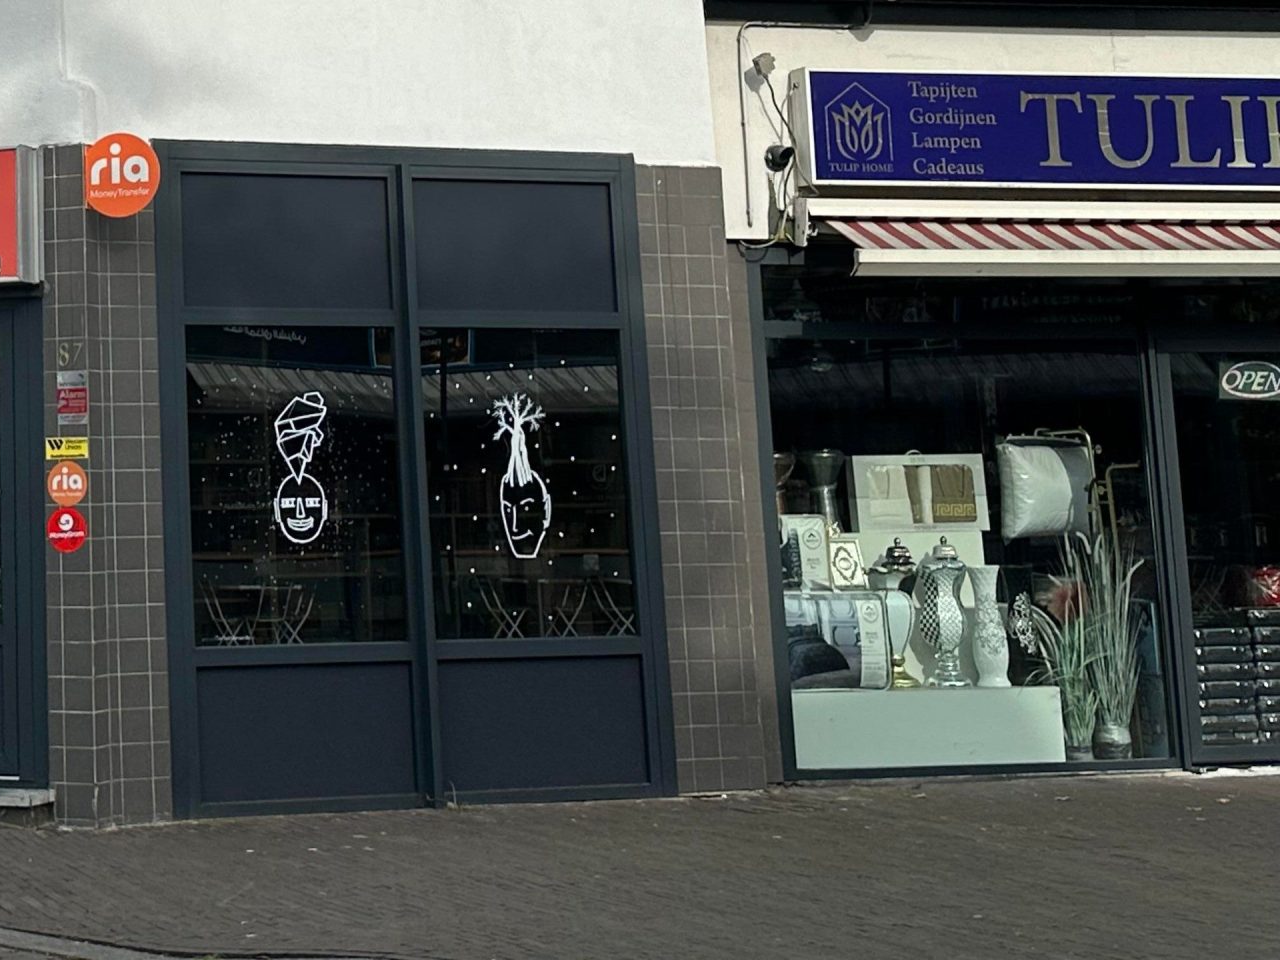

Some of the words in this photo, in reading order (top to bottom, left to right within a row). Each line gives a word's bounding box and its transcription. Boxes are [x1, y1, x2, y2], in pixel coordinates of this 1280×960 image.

[908, 80, 978, 102] Tapijten
[908, 107, 998, 130] Gordijnen
[911, 132, 982, 154] Lampen
[91, 143, 149, 185] ria
[828, 162, 860, 172] TULIP
[862, 163, 894, 173] HOME
[912, 157, 985, 176] Cadeaus
[90, 189, 117, 199] Money
[117, 186, 150, 197] Transfer
[58, 342, 83, 367] 87
[1222, 370, 1280, 391] OPEN
[52, 467, 83, 490] ria
